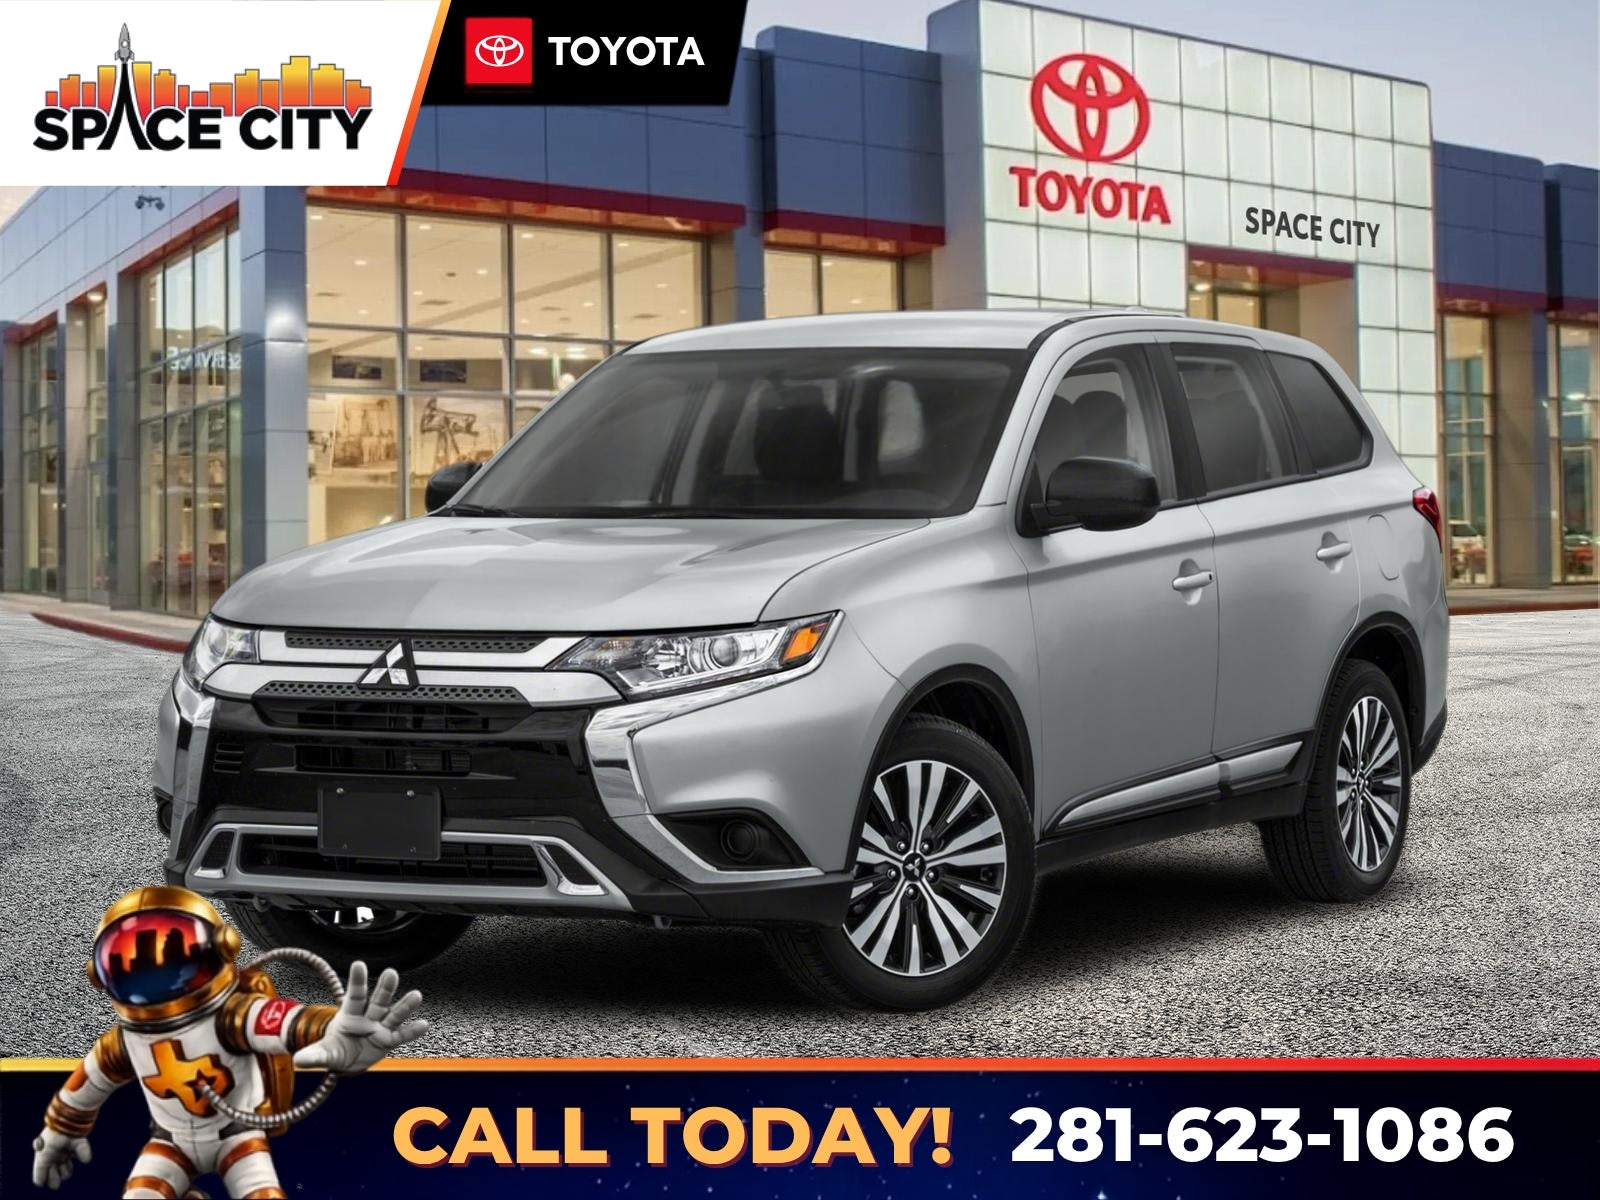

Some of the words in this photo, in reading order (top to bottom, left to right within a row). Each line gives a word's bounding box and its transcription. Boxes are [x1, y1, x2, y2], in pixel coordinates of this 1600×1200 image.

[1009, 165, 1171, 225] TOYOTA
[1245, 206, 1323, 242] SPACE
[1329, 218, 1381, 248] CITY
